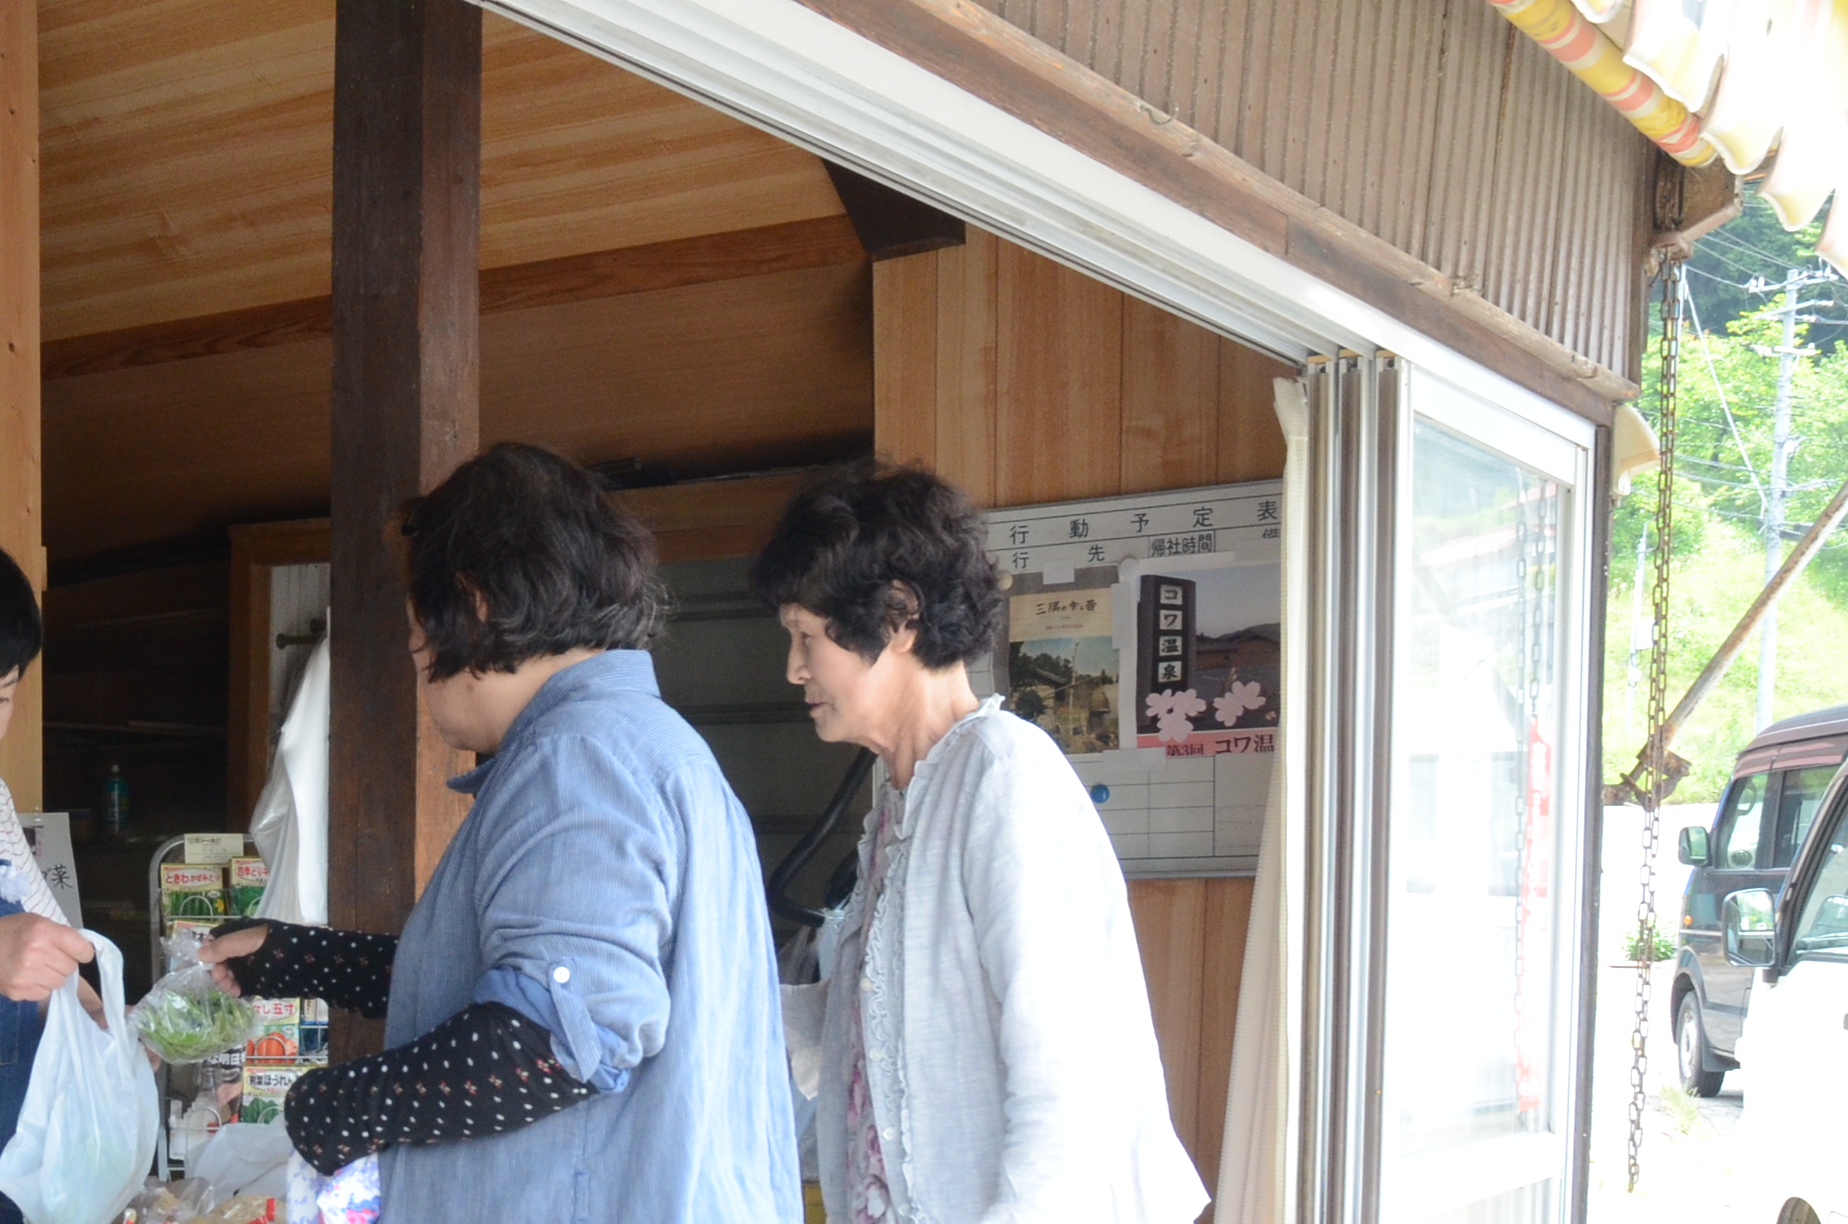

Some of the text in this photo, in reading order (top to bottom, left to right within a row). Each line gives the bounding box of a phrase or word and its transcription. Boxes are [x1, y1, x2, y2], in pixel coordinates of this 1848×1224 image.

[1009, 500, 1279, 546] 行動予定表
[1151, 533, 1213, 557] 帰社時間
[1159, 586, 1181, 681] コワ温泉
[1214, 733, 1275, 755] コワ温
